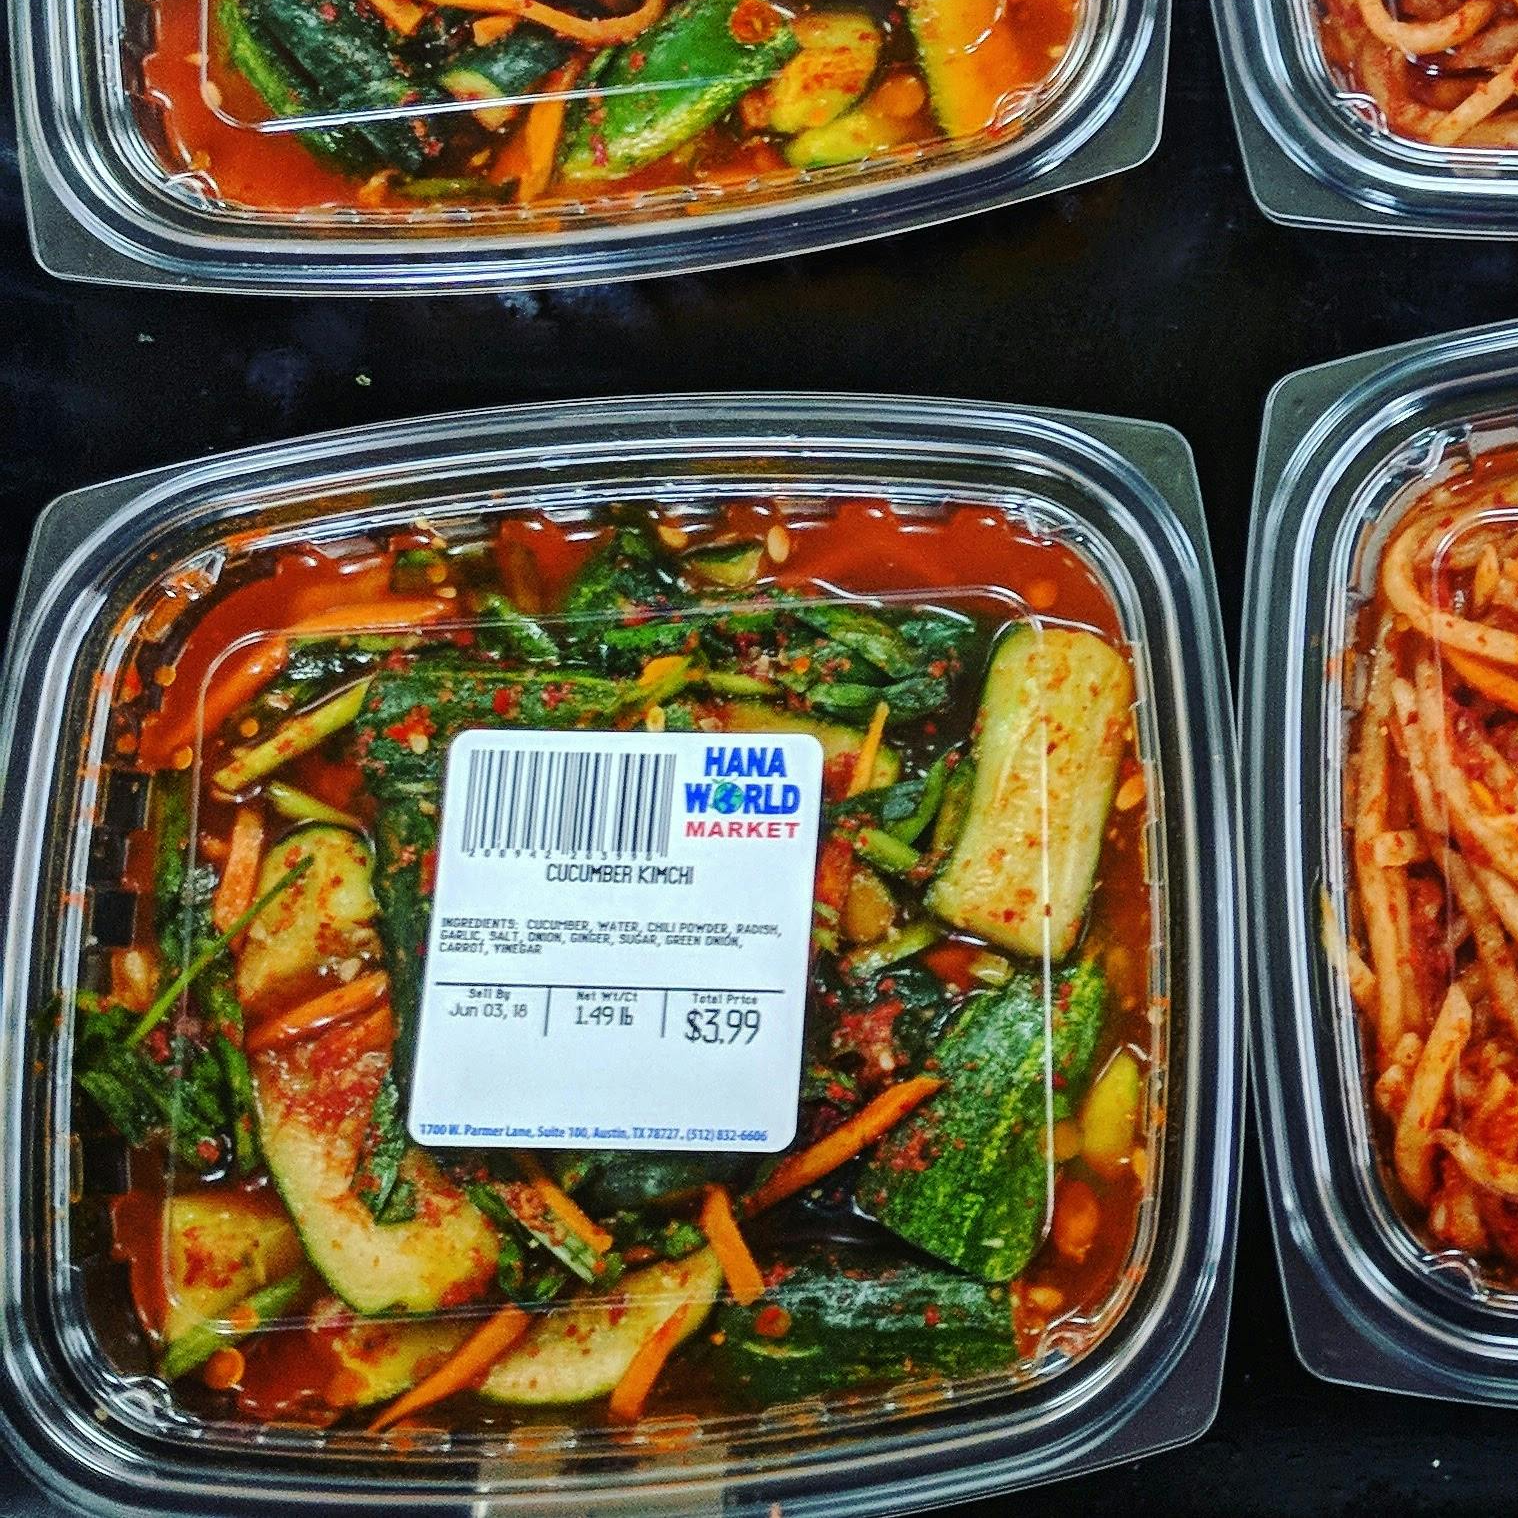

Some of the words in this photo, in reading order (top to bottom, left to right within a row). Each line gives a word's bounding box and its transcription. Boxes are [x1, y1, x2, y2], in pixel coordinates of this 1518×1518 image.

[703, 746, 787, 778] HANA
[684, 782, 800, 815] WORLD
[685, 820, 800, 839] MARKET
[545, 863, 633, 884] CUCUMBER
[637, 865, 694, 885] KIMCHI
[646, 921, 676, 933] CHILI
[493, 943, 542, 954] VINEGAR
[664, 934, 702, 946] GREEN
[448, 1002, 479, 1017] Jun
[512, 1002, 528, 1018] 18
[575, 1005, 615, 1026] 1.49
[619, 1006, 634, 1026] lb
[684, 1007, 761, 1044] $3.99
